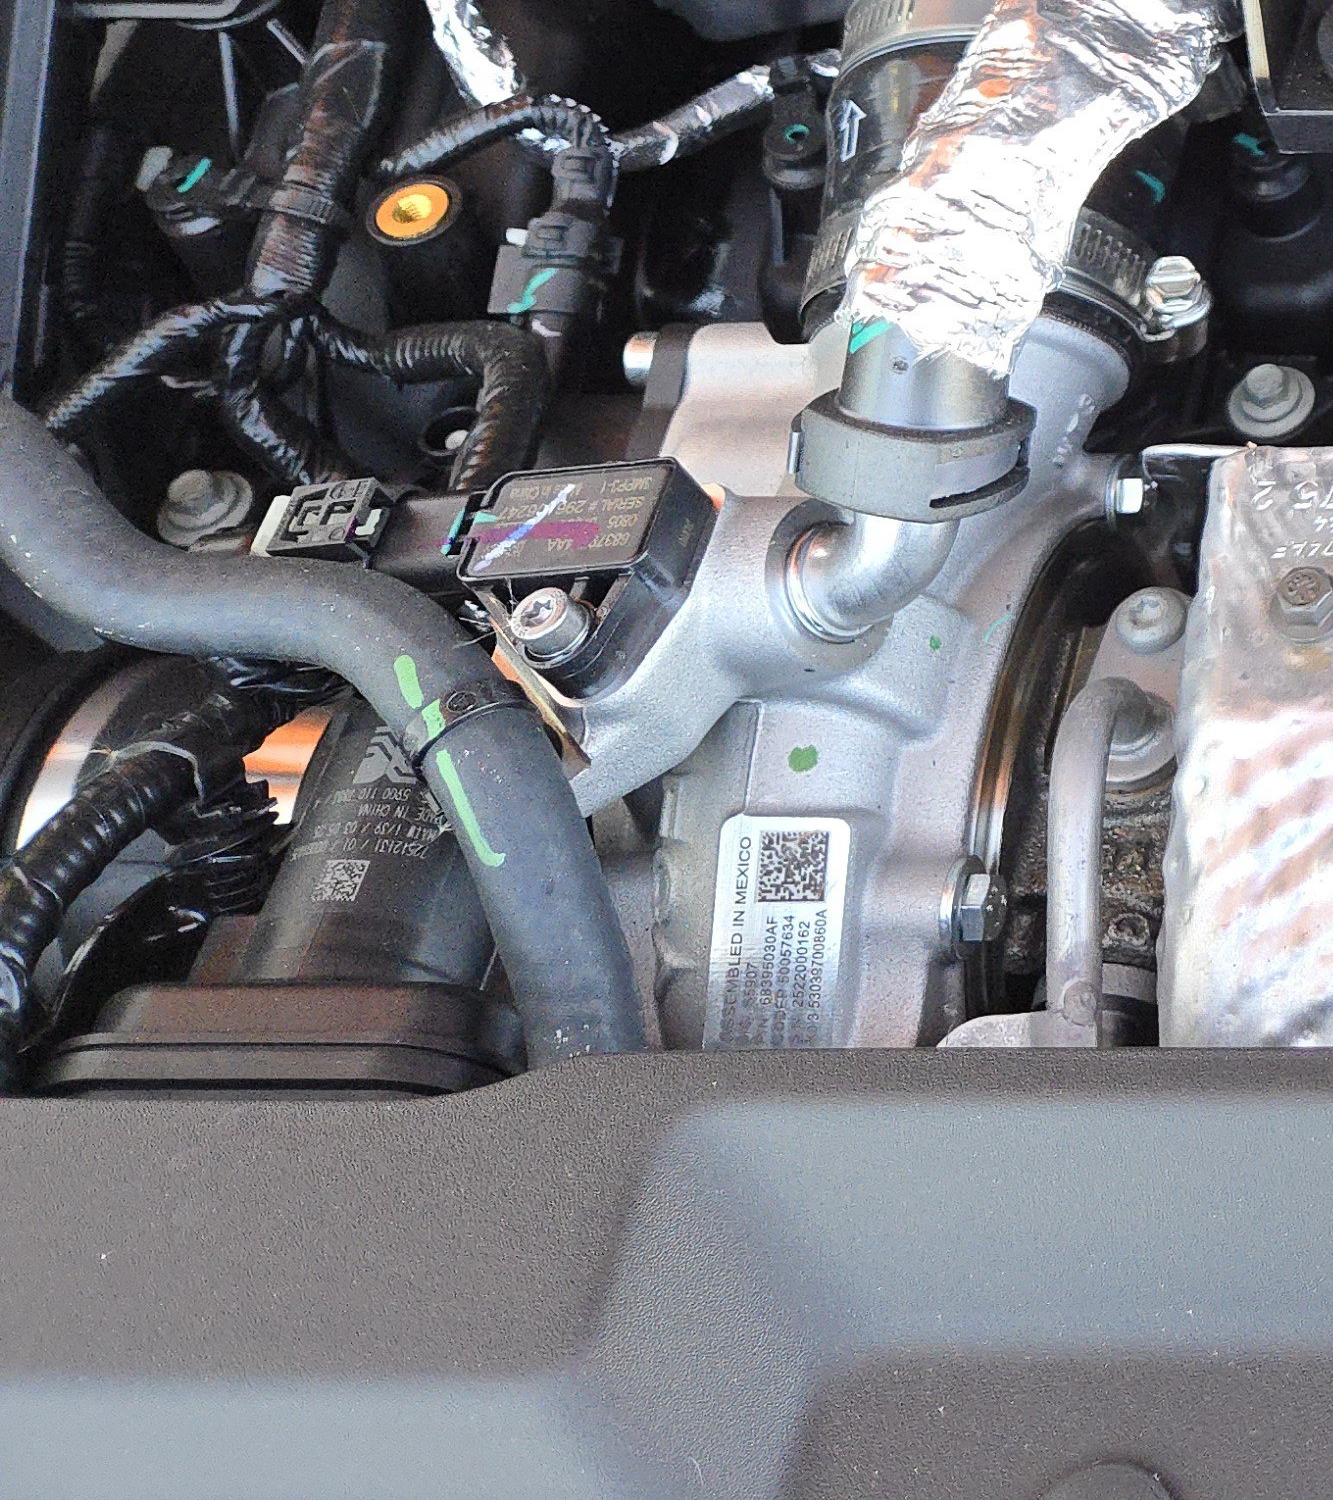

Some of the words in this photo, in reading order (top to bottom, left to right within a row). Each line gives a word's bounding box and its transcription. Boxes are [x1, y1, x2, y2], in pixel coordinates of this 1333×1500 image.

[601, 497, 646, 512] SERIAL
[357, 803, 391, 817] CHINA
[735, 836, 752, 905] MEXICO
[732, 911, 745, 927] IN
[775, 914, 795, 986] 50057634
[719, 931, 744, 1044] ASSEMBLED
[759, 915, 777, 1006] 68395030AF
[792, 921, 811, 1008] 2522000162
[808, 908, 828, 1009] 53039700860A
